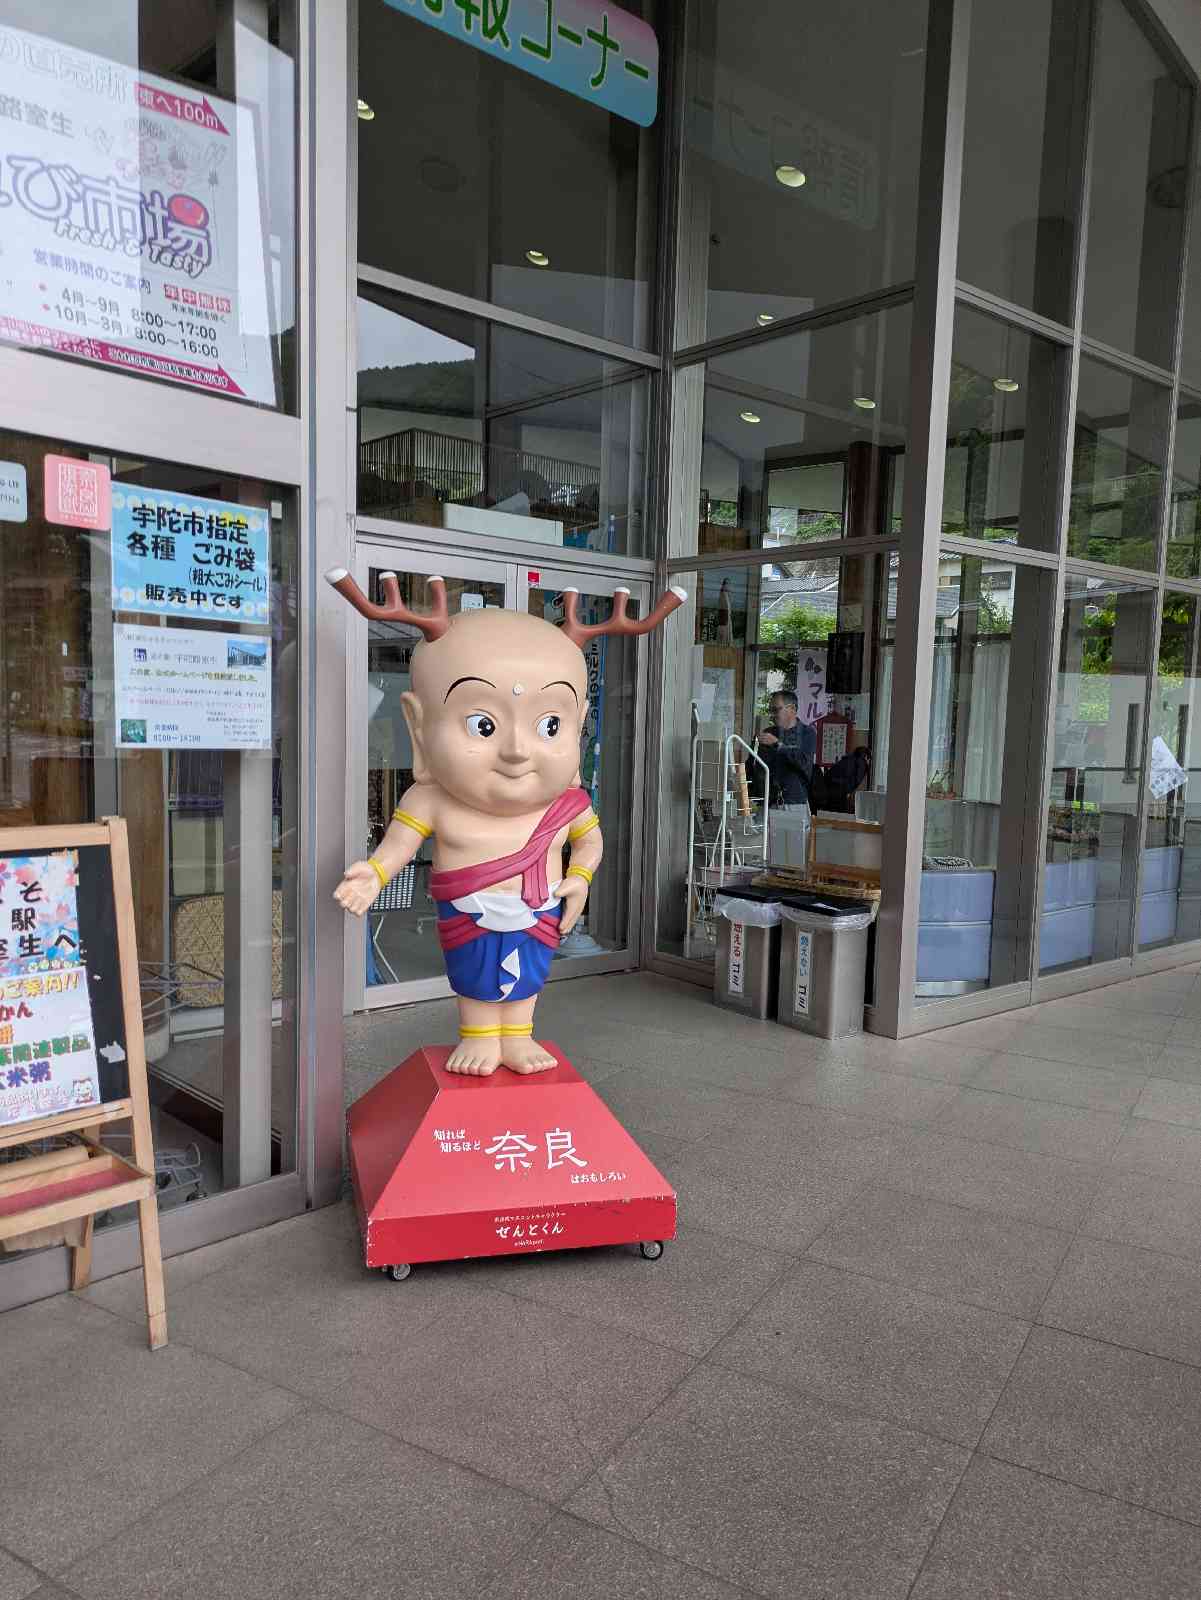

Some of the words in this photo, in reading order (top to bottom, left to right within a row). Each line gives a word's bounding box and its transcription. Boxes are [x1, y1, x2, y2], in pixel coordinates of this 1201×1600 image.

[33, 247, 151, 295] 営業時間のご案内
[148, 238, 206, 278] Tasty
[132, 503, 249, 545] 宇陀市指定
[127, 531, 176, 562] 各種
[192, 542, 256, 572] ごみ袋
[145, 583, 245, 609] 販売中です
[433, 1129, 466, 1141] 知れば
[440, 1140, 481, 1153] 知るほど
[484, 1127, 588, 1173] 奈良
[571, 1171, 626, 1184] はおもしろい
[495, 1222, 564, 1239] せんとくん
